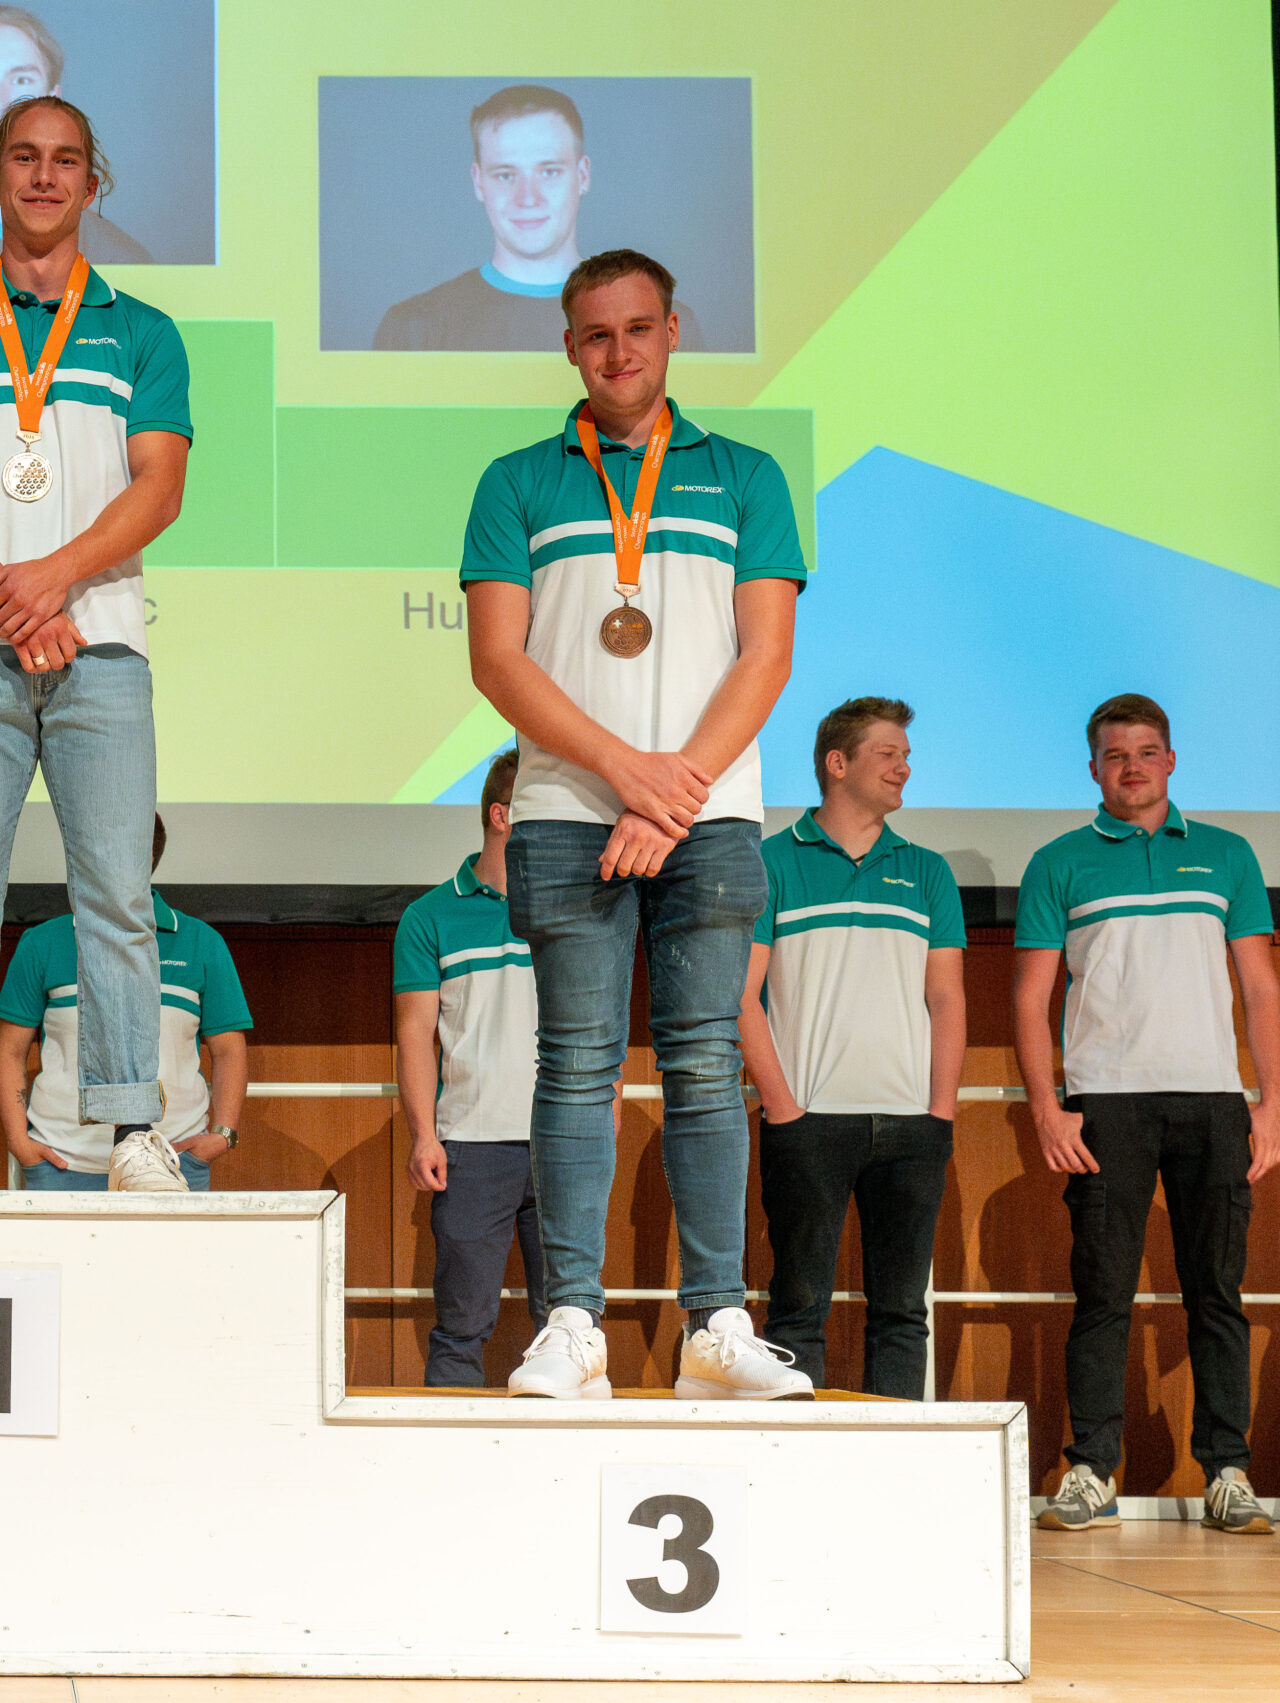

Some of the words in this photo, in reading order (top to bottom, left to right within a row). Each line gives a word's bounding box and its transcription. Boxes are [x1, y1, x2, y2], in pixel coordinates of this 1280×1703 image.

[684, 485, 723, 494] MOTOREX
[403, 592, 463, 630] Hu
[626, 1494, 720, 1614] 3
